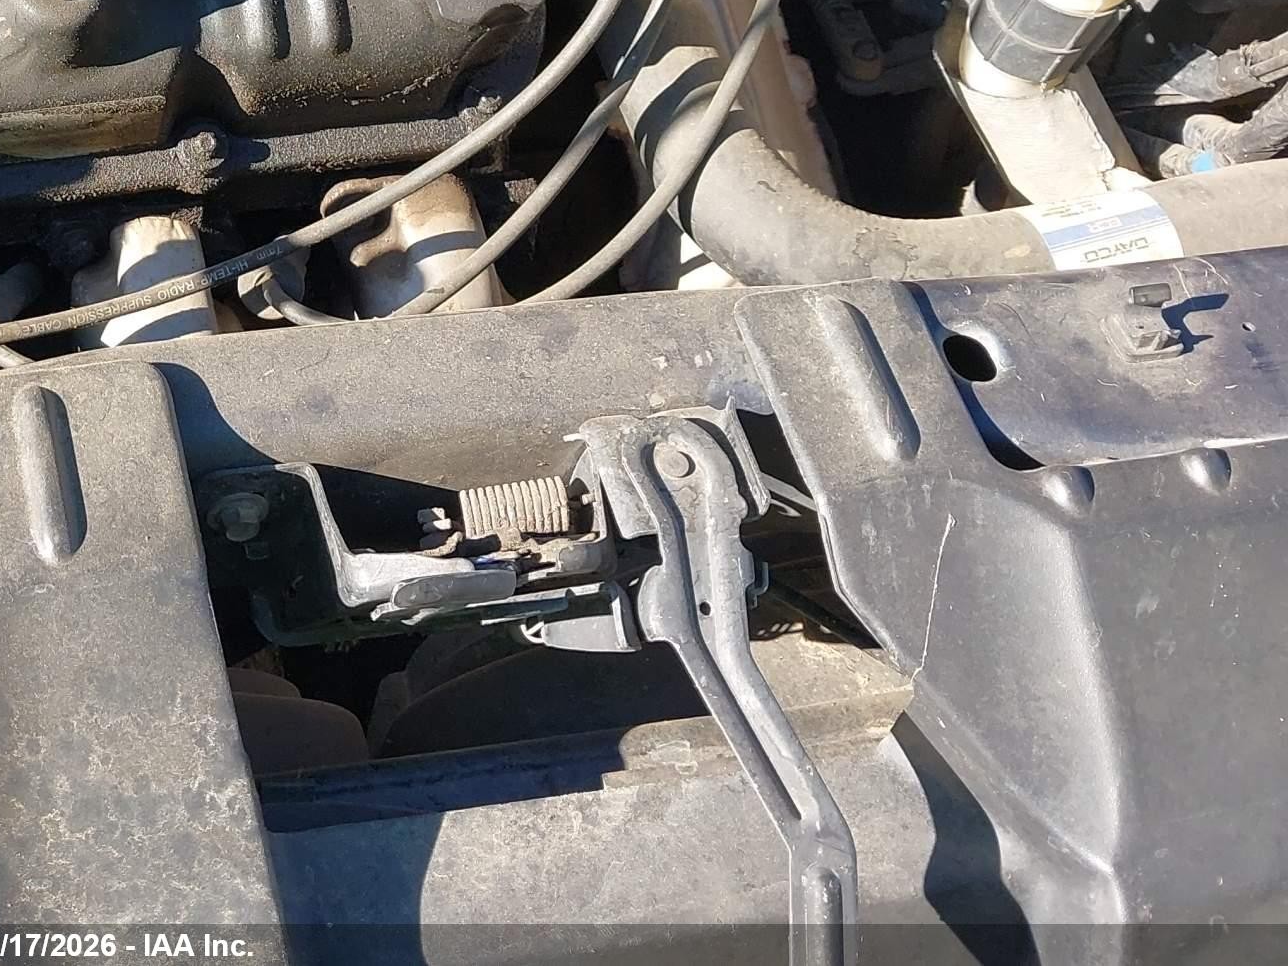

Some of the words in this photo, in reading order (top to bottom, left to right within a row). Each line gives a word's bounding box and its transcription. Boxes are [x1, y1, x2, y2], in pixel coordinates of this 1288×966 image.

[199, 258, 250, 285] HI-TEMP
[157, 278, 196, 300] RADIO
[67, 295, 152, 328] SUPPRESSION
[21, 319, 62, 337] CABLE
